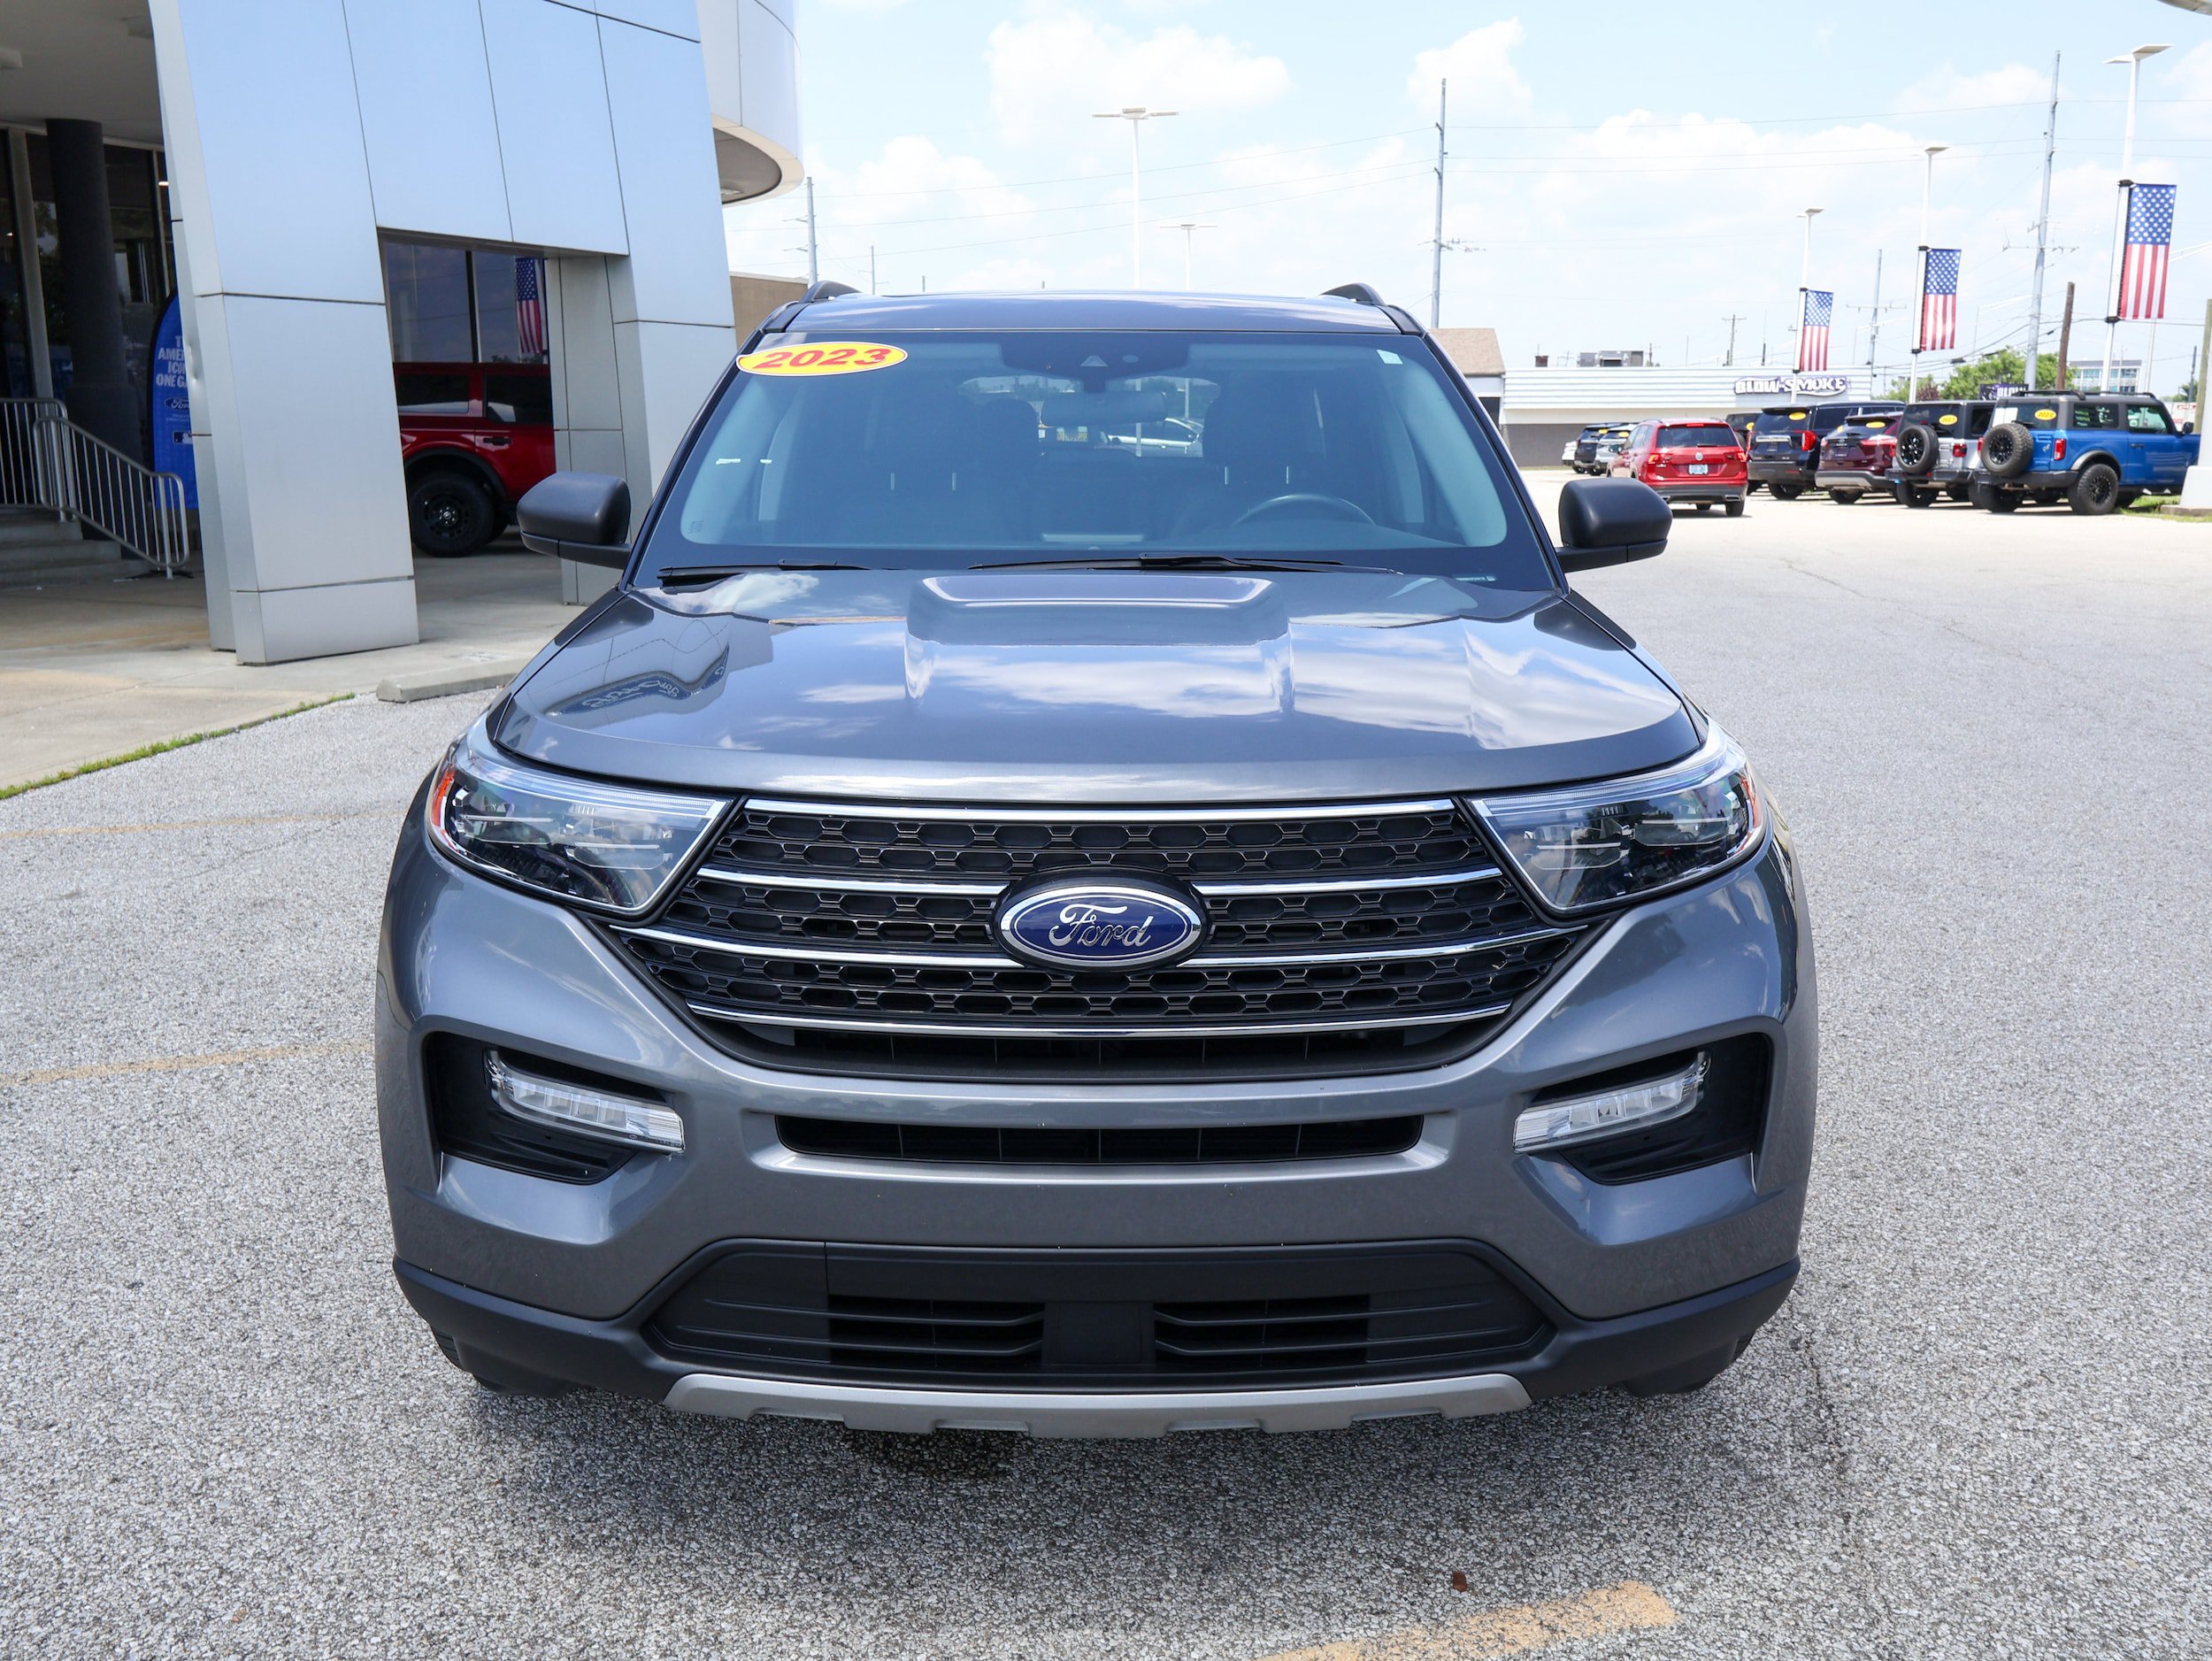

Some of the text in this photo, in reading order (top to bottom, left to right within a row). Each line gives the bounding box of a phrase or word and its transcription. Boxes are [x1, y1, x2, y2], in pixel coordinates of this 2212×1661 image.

[753, 348, 892, 370] 2023
[156, 373, 176, 388] ONE
[171, 398, 189, 410] For
[1048, 904, 1154, 948] Ford
